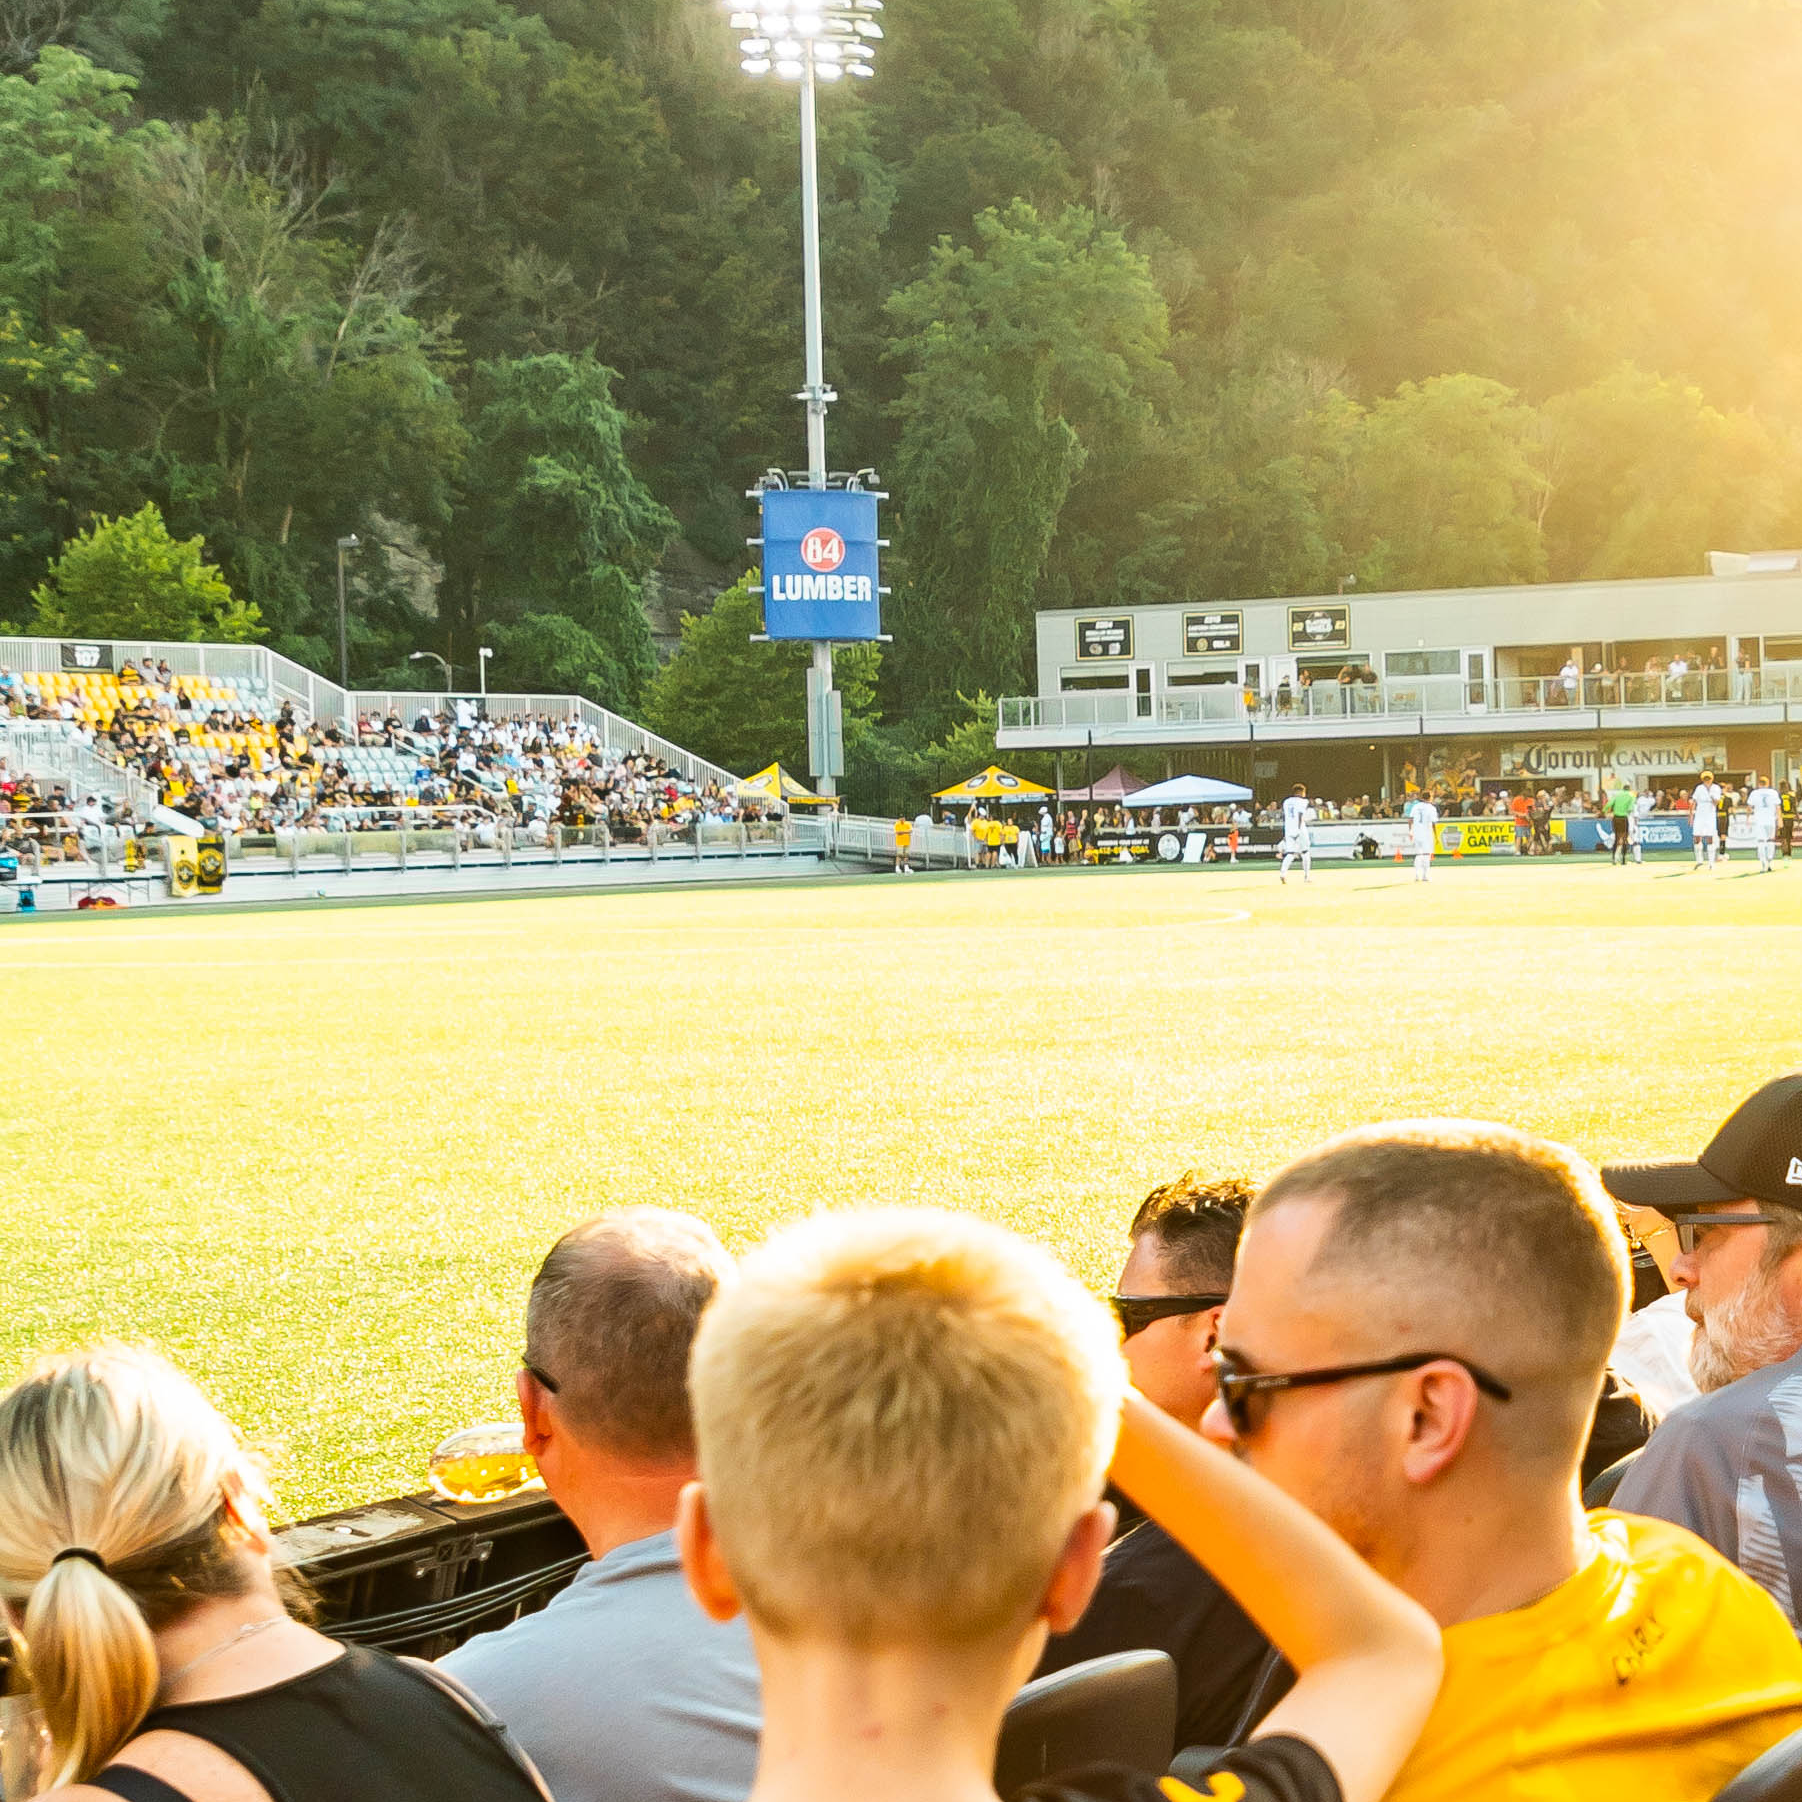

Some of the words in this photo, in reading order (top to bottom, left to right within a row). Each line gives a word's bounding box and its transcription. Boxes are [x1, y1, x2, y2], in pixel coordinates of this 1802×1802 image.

[806, 536, 840, 564] 84
[772, 574, 872, 602] LUMBER
[1616, 748, 1697, 767] CANTINA
[1467, 824, 1506, 834] EVERY
